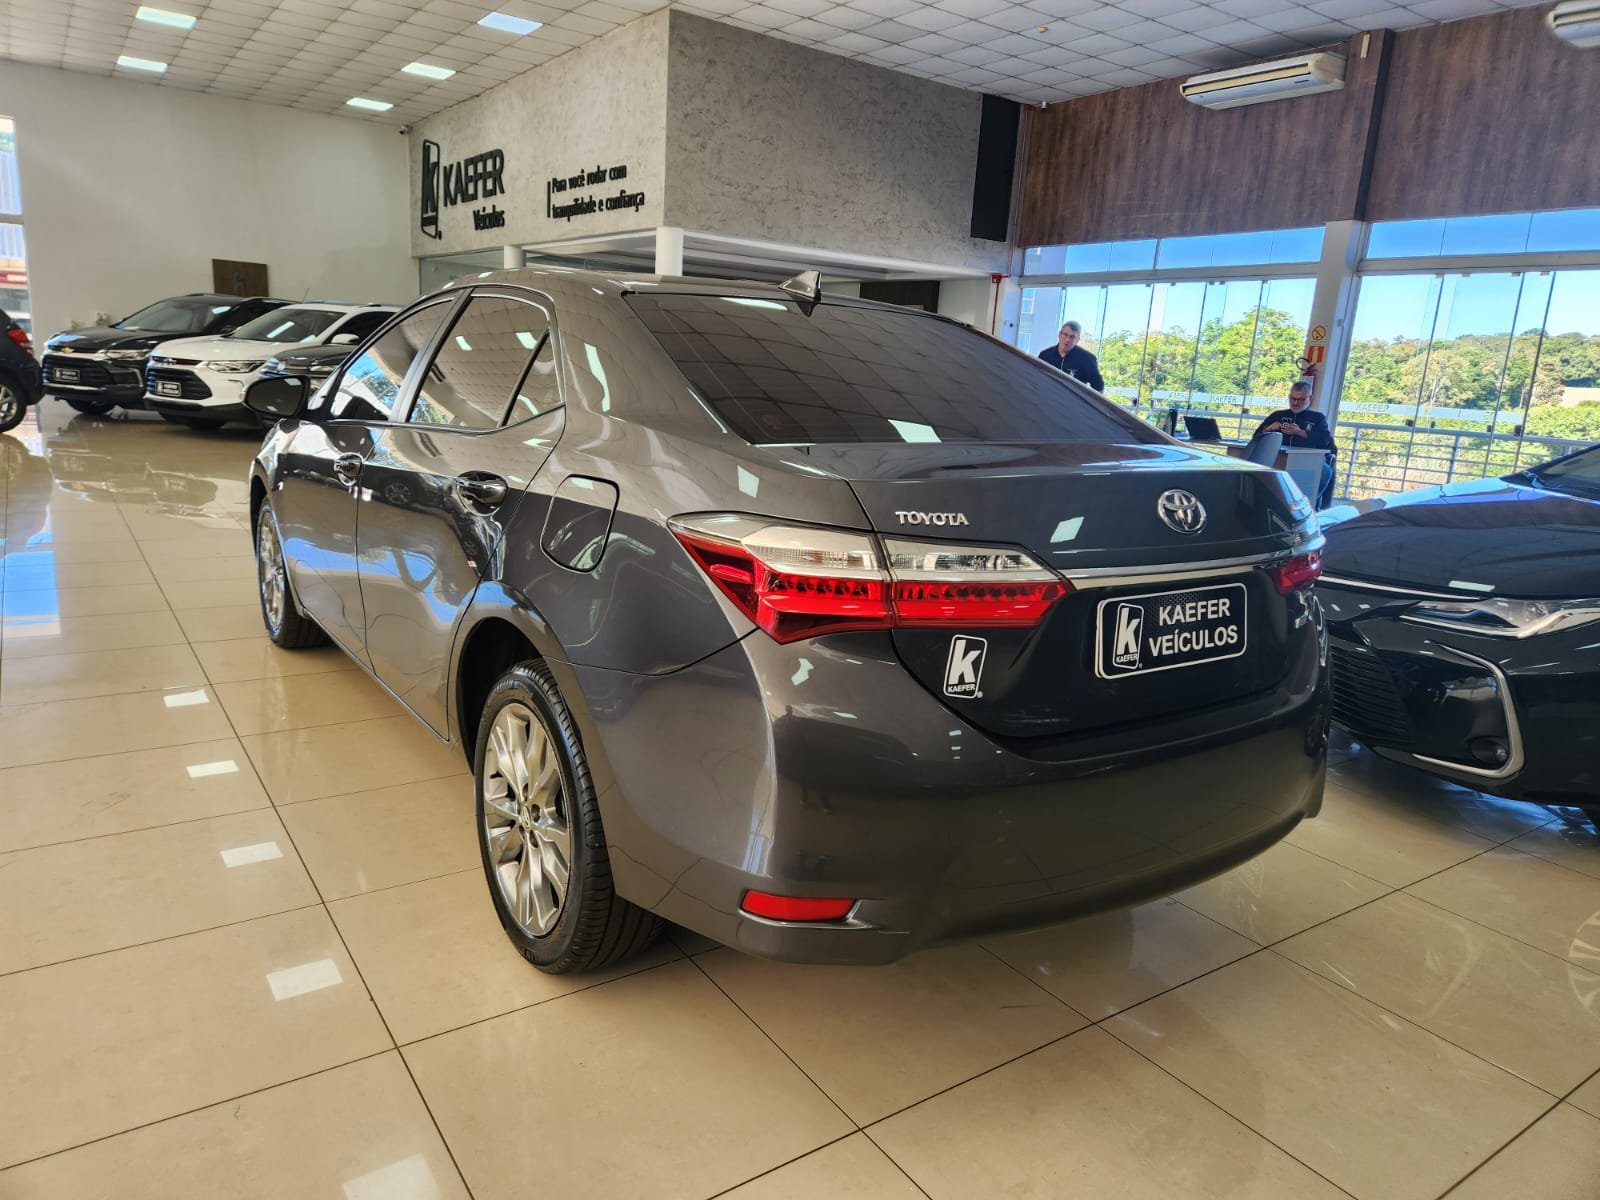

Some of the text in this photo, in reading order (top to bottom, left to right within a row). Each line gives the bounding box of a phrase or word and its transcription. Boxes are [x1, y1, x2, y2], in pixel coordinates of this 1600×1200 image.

[443, 148, 505, 208] KAEFER
[552, 165, 627, 194] Para você rodar com
[472, 204, 505, 231] Veículos
[552, 189, 645, 222] tranquilidade e confiança
[894, 510, 970, 527] TOYOTA
[1159, 598, 1231, 627] KAEFER
[1148, 624, 1239, 657] VEÍCULOS
[1116, 653, 1139, 664] KAEFER
[947, 683, 976, 693] KAEFER
